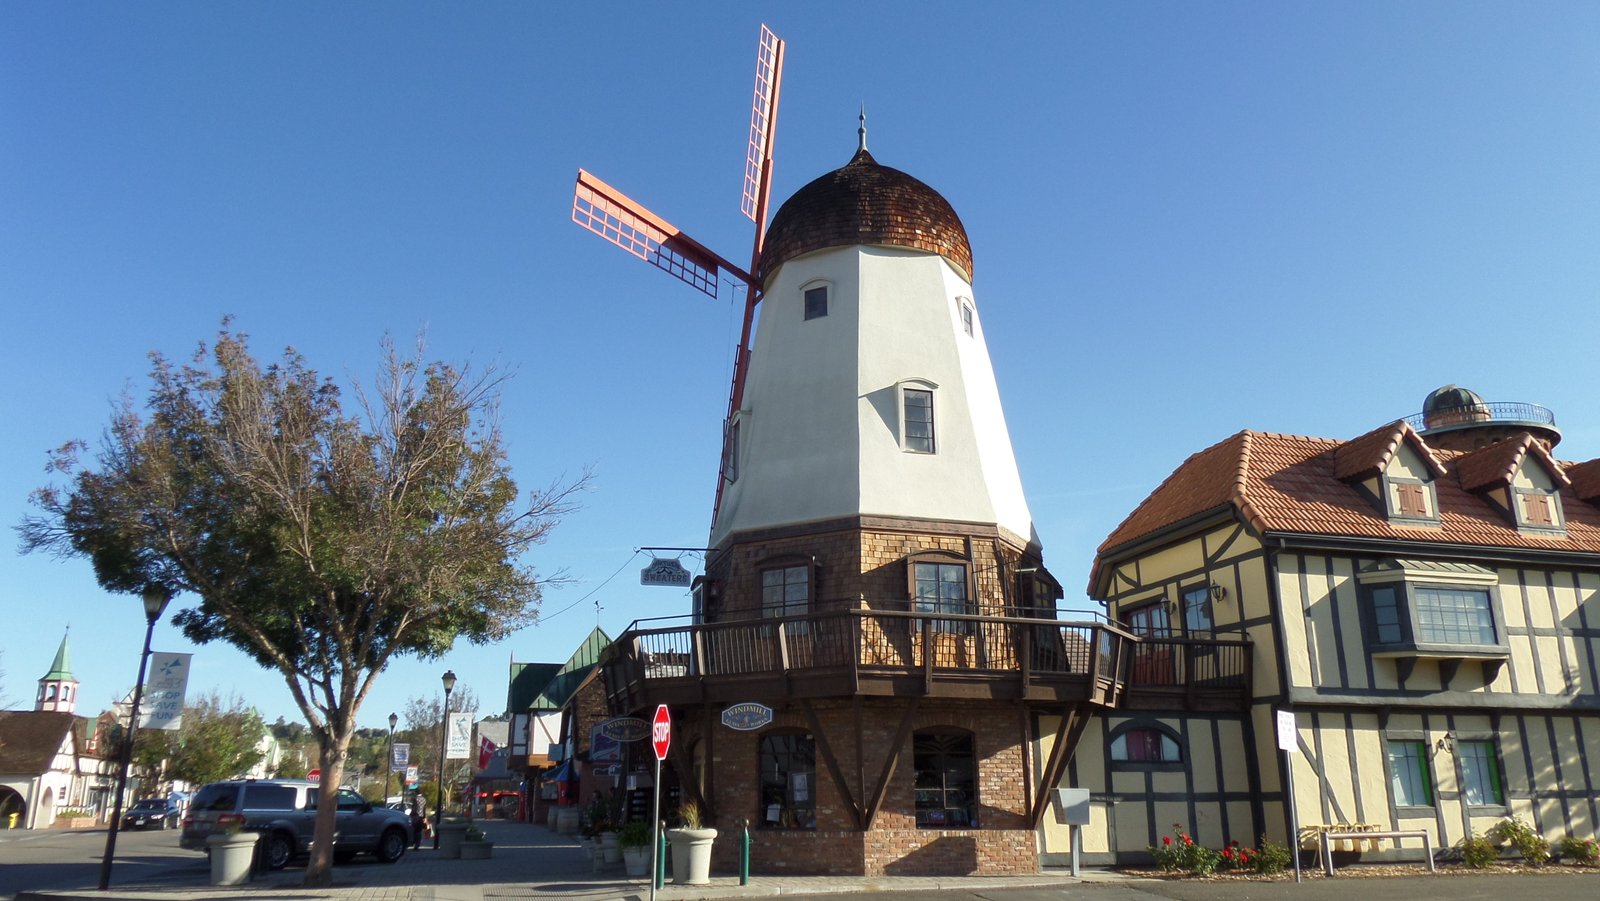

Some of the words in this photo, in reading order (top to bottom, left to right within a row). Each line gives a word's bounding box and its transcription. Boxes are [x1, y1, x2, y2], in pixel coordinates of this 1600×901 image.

[644, 572, 688, 583] SWEATERS
[149, 701, 177, 710] SAVE
[151, 711, 173, 720] FUN
[727, 705, 767, 717] WINDMILL
[607, 720, 648, 730] WINDMILL
[654, 722, 669, 743] STOP
[308, 774, 320, 782] STO
